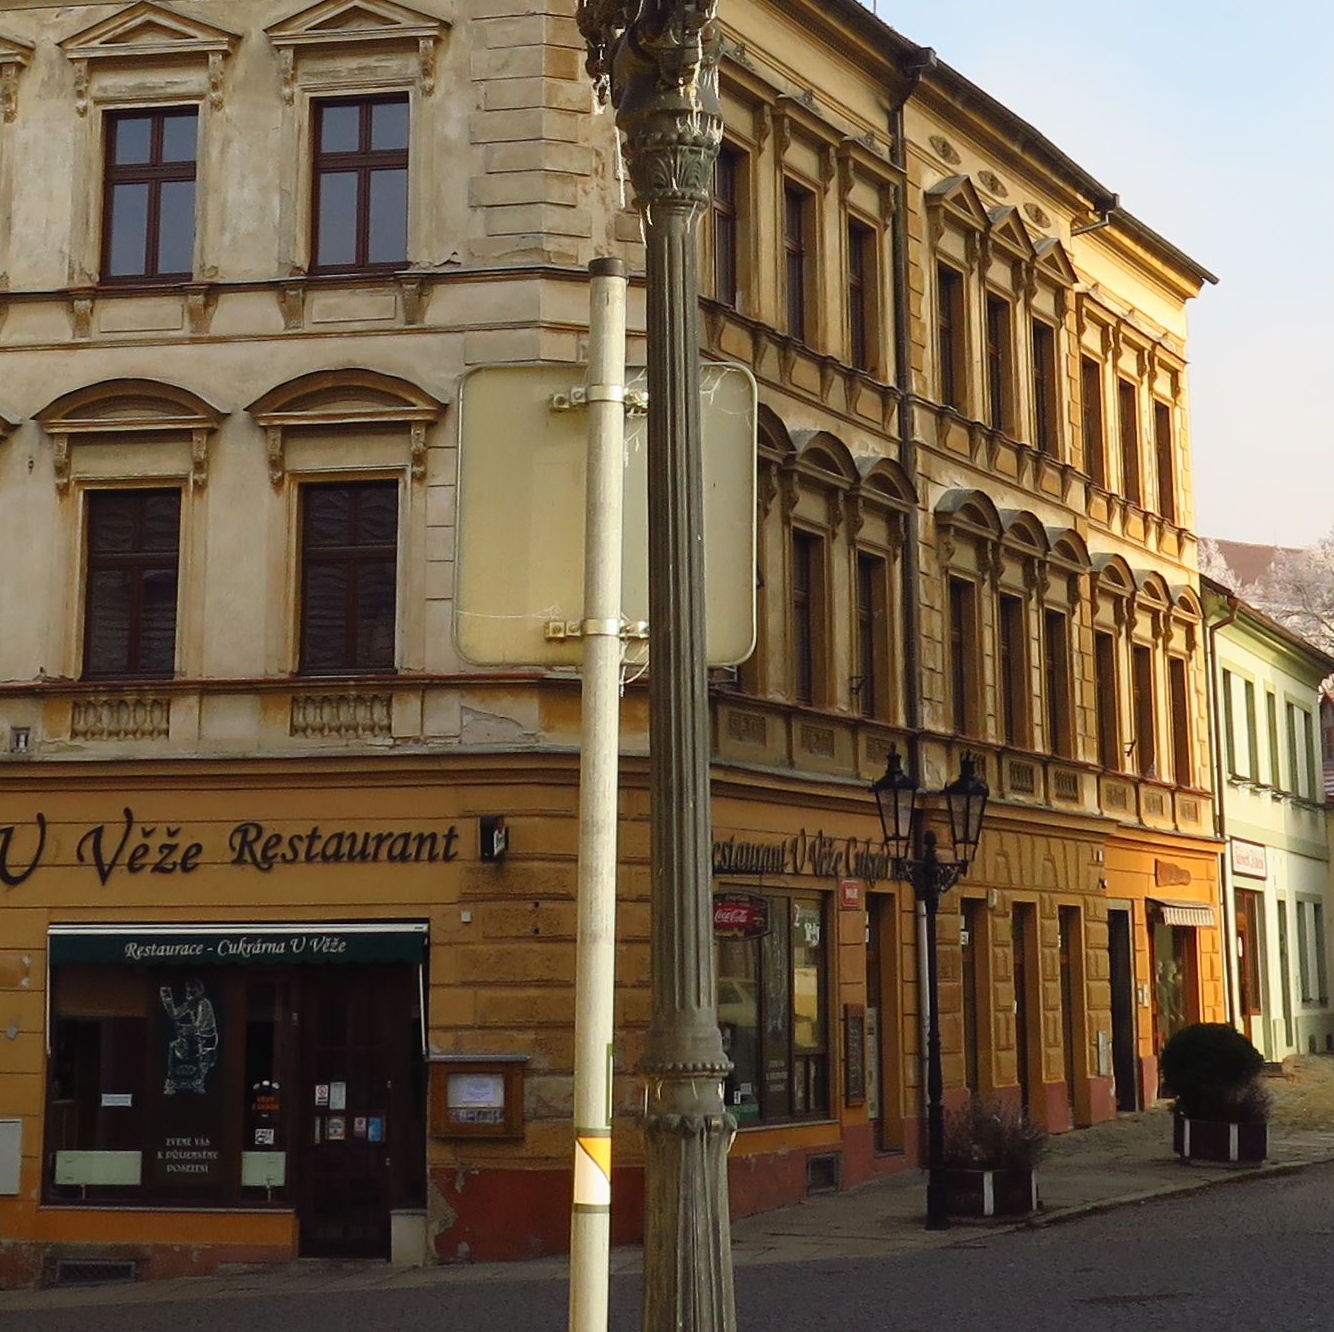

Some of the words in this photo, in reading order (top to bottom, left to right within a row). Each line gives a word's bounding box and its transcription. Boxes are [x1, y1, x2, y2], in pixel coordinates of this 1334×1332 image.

[77, 807, 203, 886] Věže
[229, 822, 460, 872] Restaurant
[124, 941, 204, 960] Restaurace
[217, 937, 286, 958] Cukrárna
[290, 937, 307, 955] U
[310, 935, 347, 954] Věže
